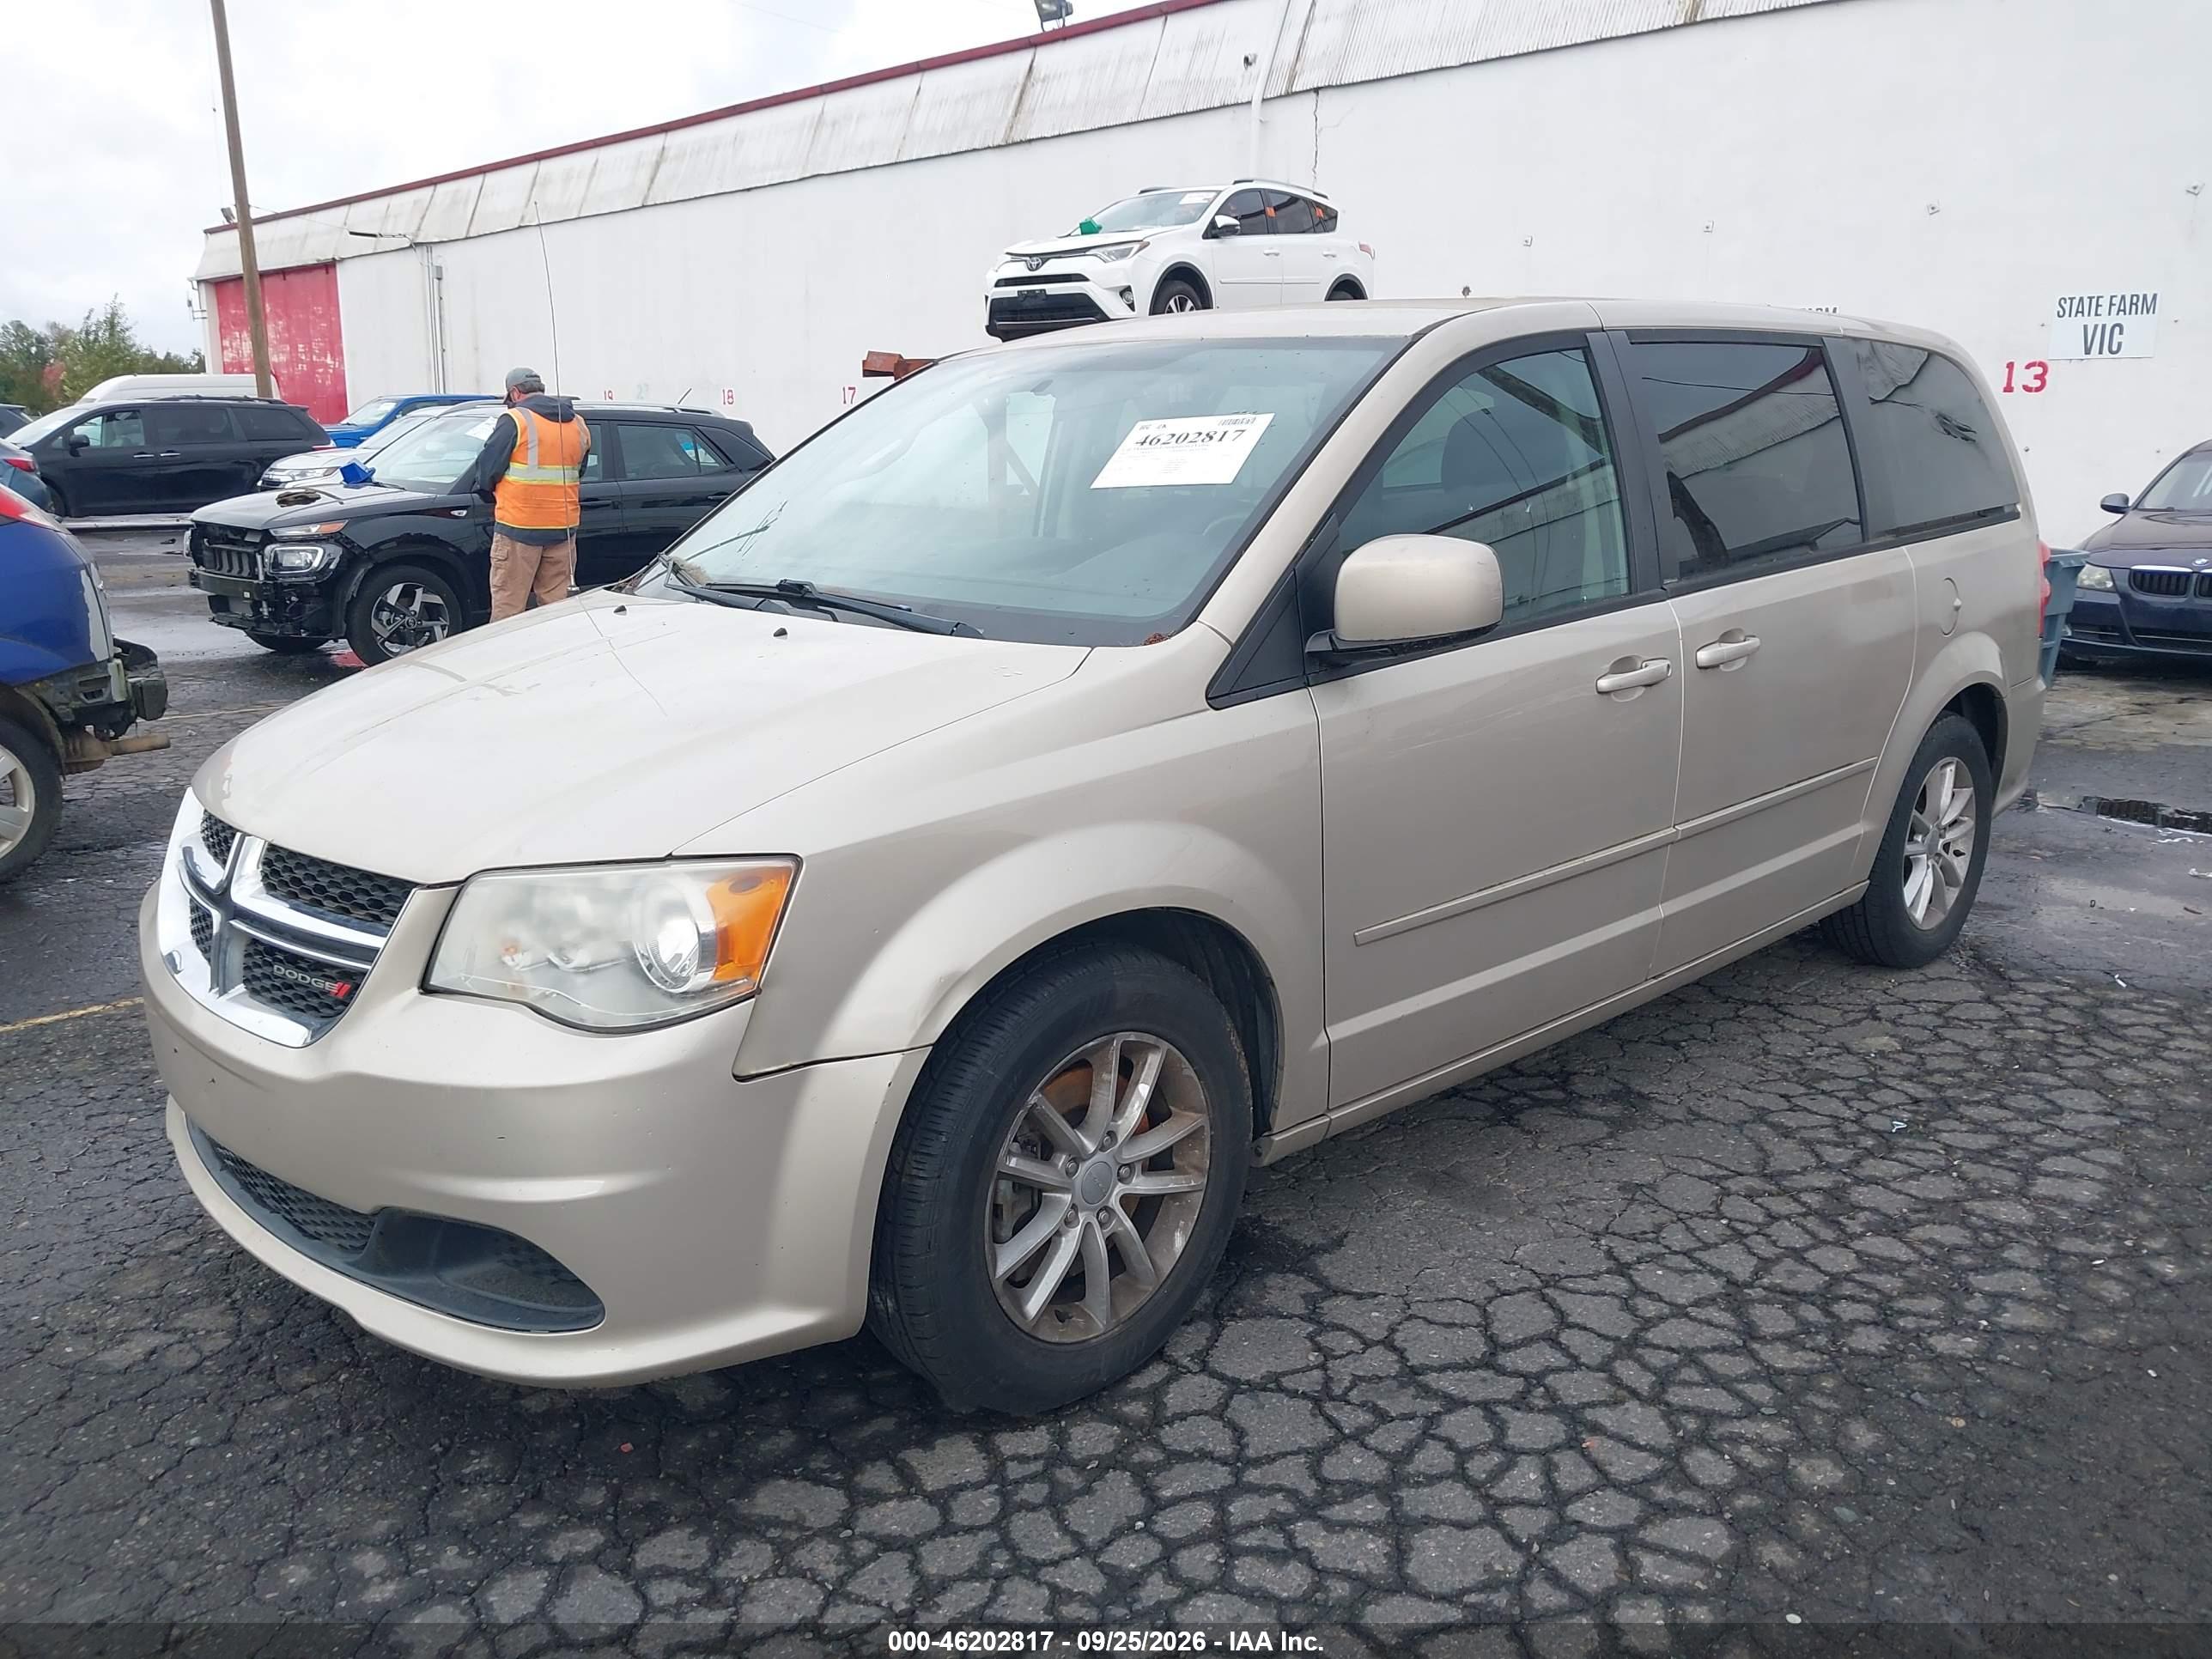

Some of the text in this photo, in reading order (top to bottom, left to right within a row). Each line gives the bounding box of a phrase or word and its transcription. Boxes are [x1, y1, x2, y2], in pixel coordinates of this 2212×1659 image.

[2057, 293, 2158, 319] STATE FARM
[2082, 322, 2124, 356] VIC
[2002, 361, 2049, 393] 13
[722, 389, 734, 404] 18
[842, 386, 856, 404] 17
[1135, 428, 1248, 447] 46202817
[273, 964, 339, 994] DODGE
